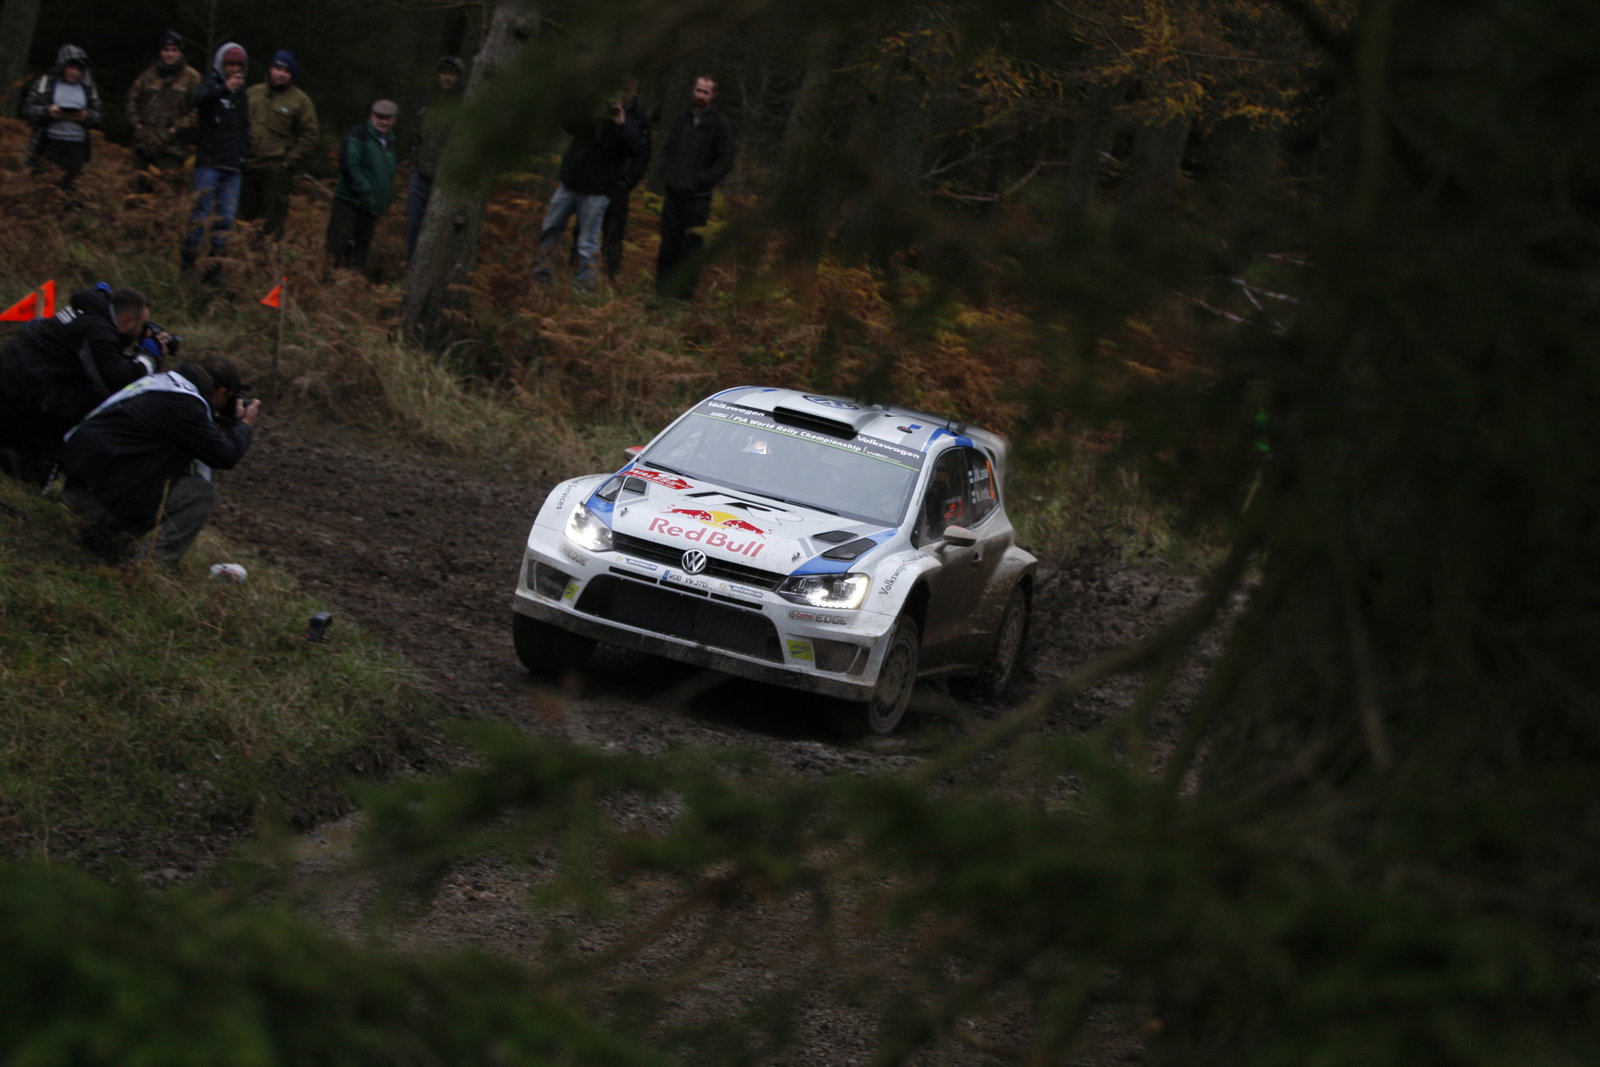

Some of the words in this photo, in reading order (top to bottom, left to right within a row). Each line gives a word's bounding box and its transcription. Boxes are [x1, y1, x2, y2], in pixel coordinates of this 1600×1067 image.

[708, 401, 765, 417] Volkswagen
[733, 415, 748, 424] FIA
[749, 418, 775, 430] World
[776, 425, 799, 436] Rally
[800, 430, 862, 452] Championship
[857, 434, 920, 459] Volkswagen
[648, 516, 707, 542] Red
[705, 530, 765, 558] Bull
[815, 613, 849, 626] EDGE
